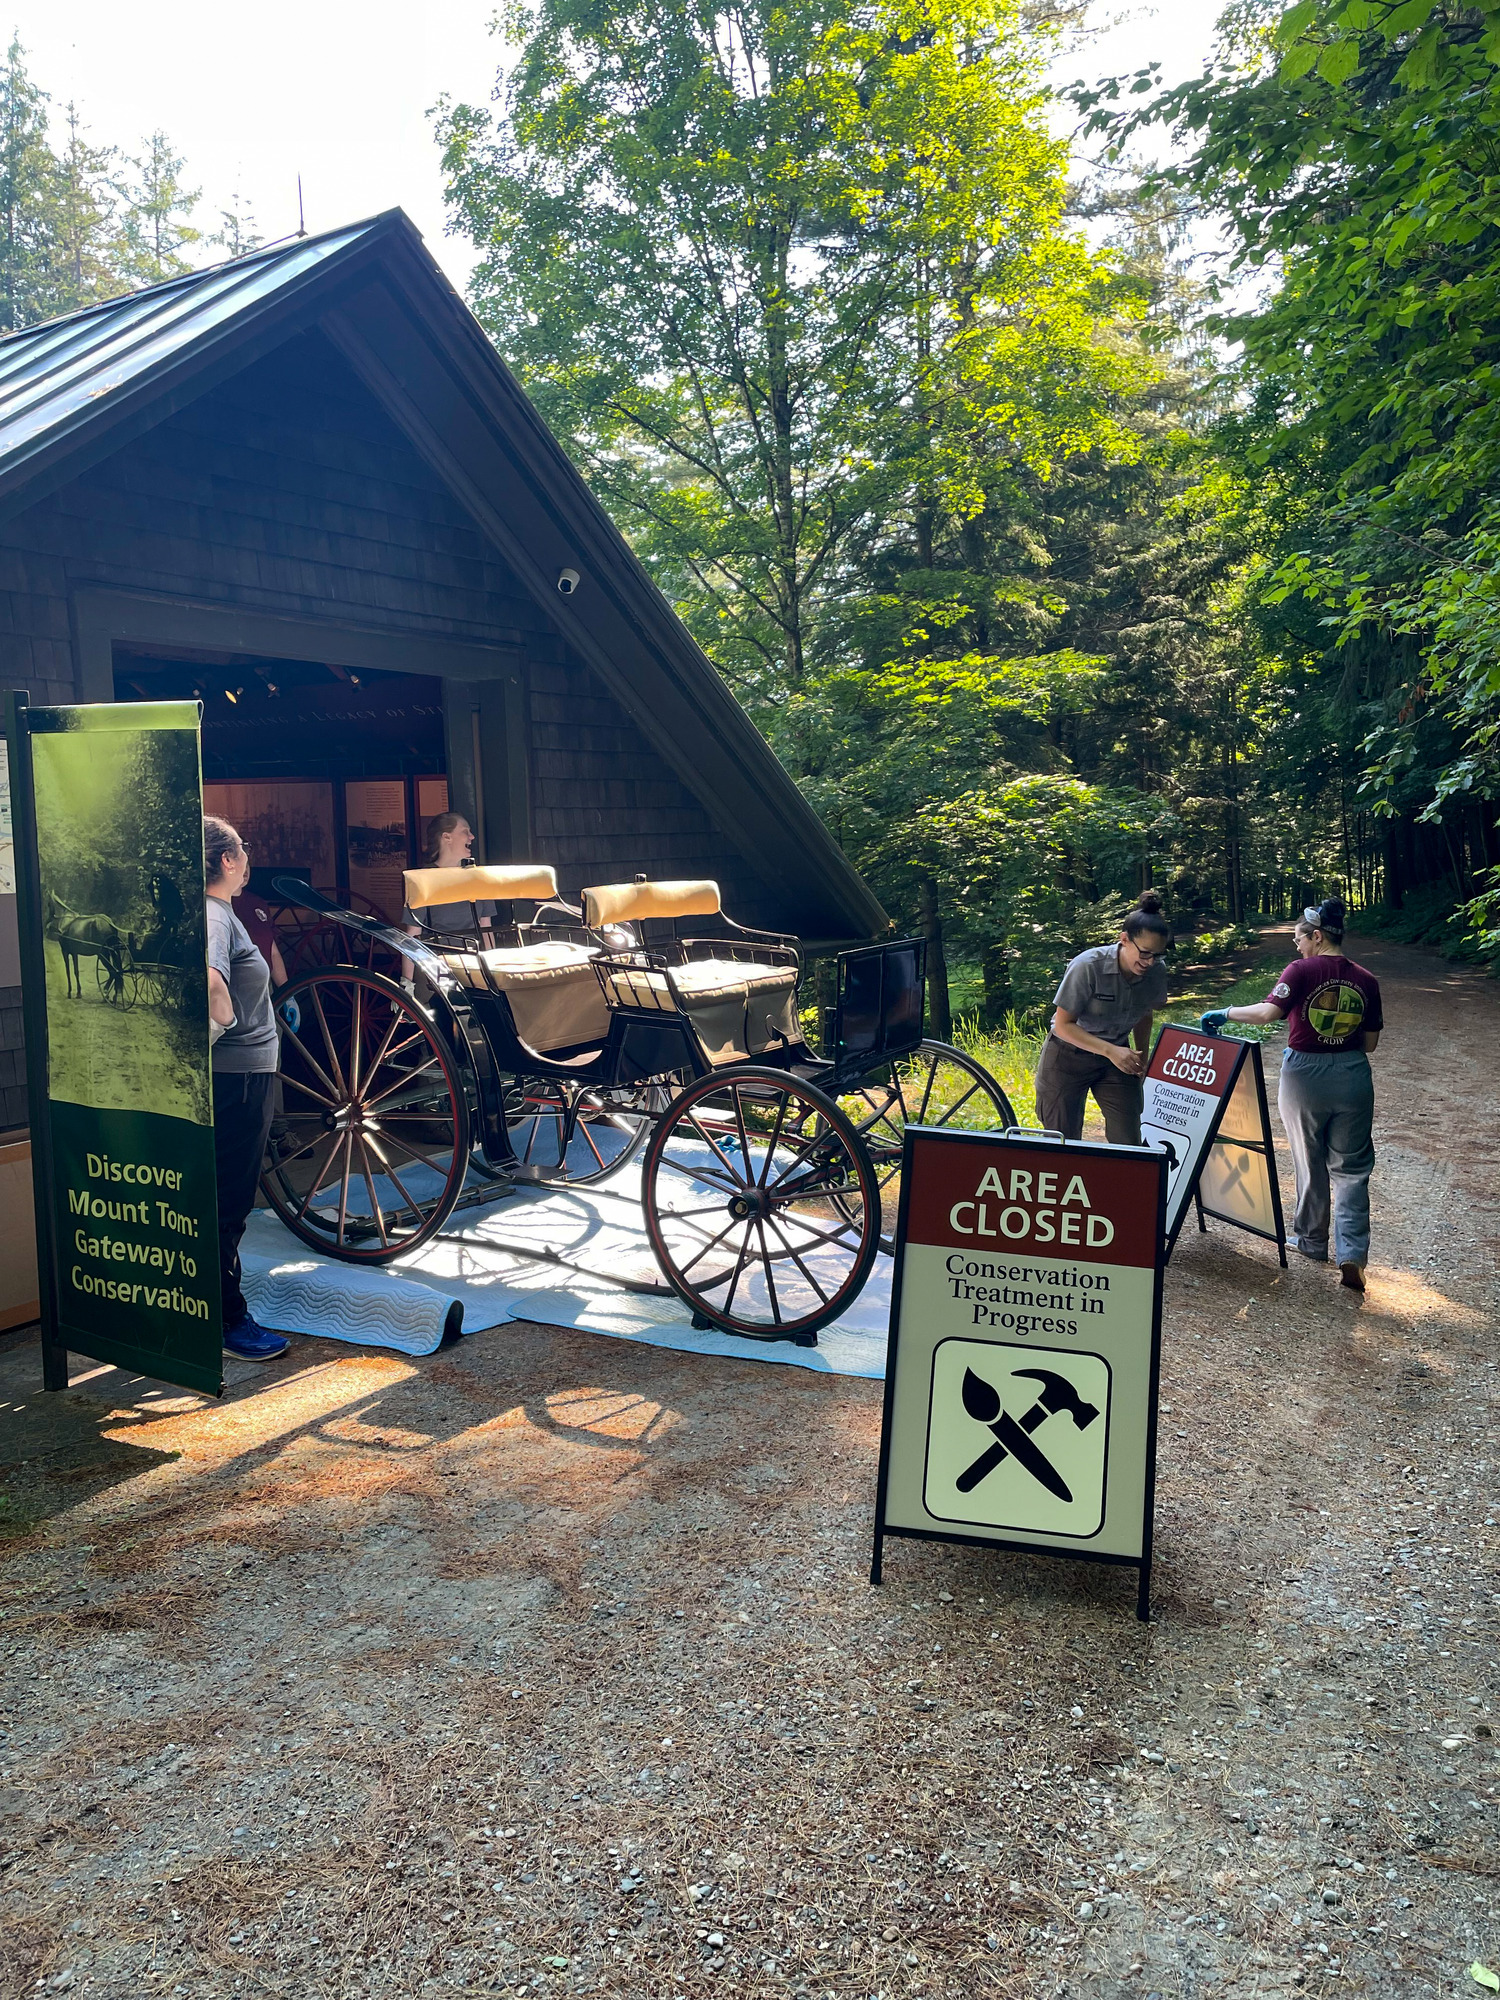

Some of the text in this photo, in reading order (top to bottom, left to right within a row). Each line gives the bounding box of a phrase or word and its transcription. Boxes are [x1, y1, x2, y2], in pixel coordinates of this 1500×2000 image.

[204, 716, 288, 728] ONTINUING
[1175, 1042, 1214, 1066] AREA
[1317, 1034, 1345, 1045] CRDIP
[1162, 1058, 1217, 1086] CLOSED
[1152, 1094, 1200, 1118] Treatment in
[1154, 1083, 1206, 1107] Conservation
[1154, 1108, 1188, 1127] Progress
[86, 1152, 183, 1191] Discover
[975, 1166, 1092, 1208] AREA
[68, 1188, 199, 1238] Mount Tom:
[949, 1201, 1115, 1248] CLOSED
[75, 1229, 197, 1278] Gateway to
[945, 1254, 1111, 1292] Conservation
[71, 1265, 209, 1320] Conservation
[948, 1277, 1105, 1315] Treatment in
[972, 1304, 1078, 1336] Progress
